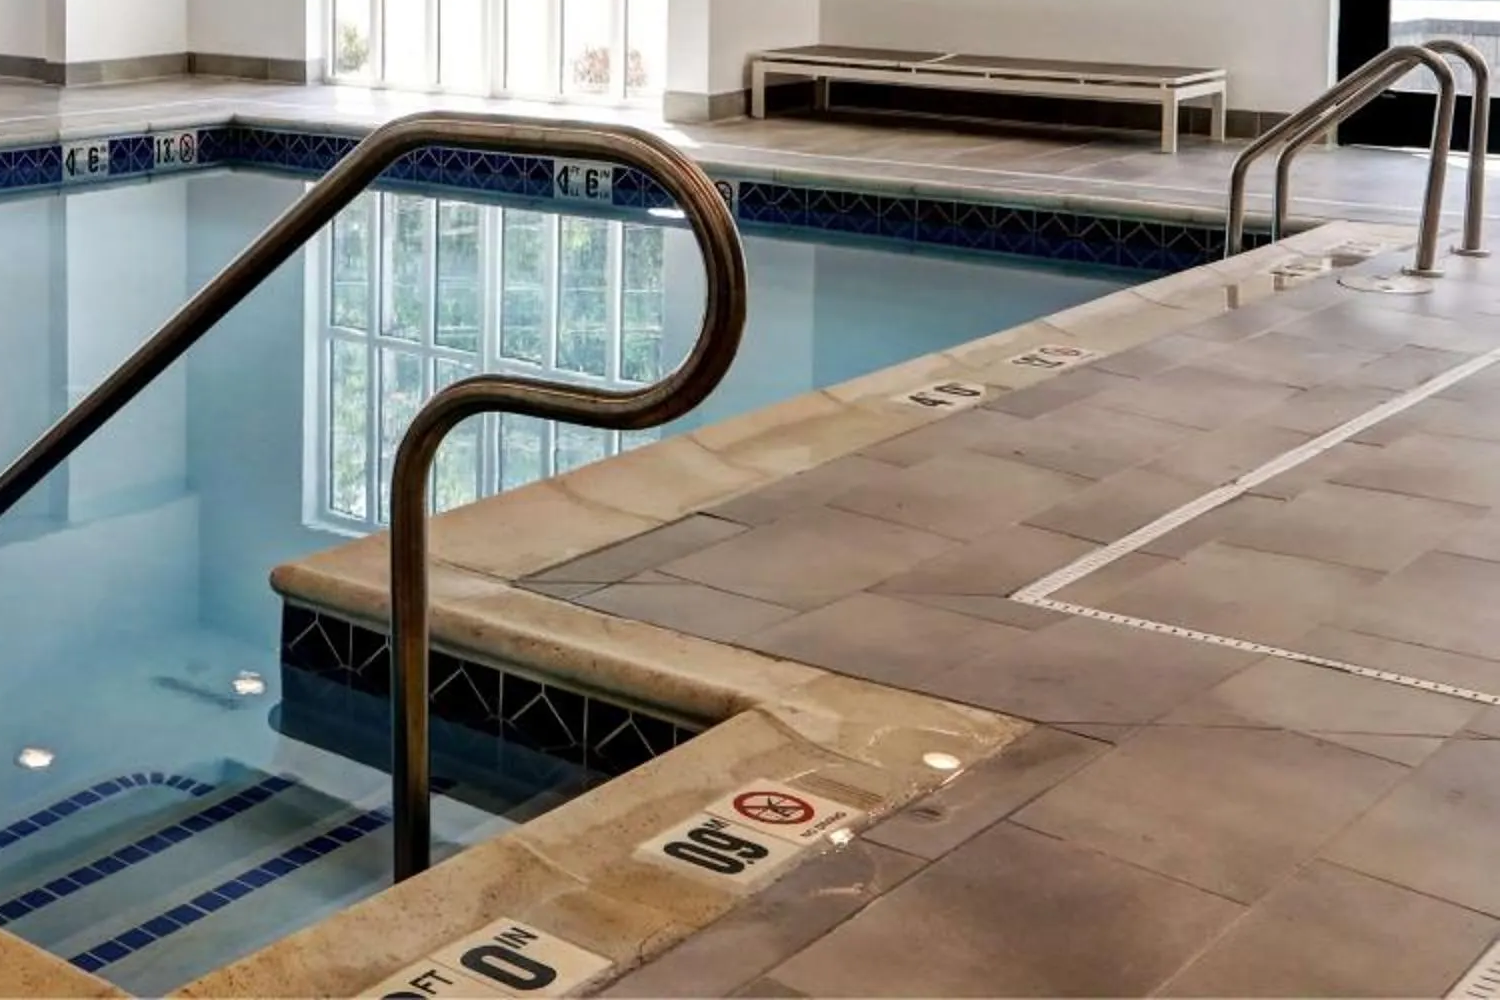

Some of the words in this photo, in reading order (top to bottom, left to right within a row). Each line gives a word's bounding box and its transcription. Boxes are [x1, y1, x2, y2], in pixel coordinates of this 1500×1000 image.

[493, 926, 539, 949] IN
[408, 968, 454, 996] FT
[460, 945, 557, 991] 0
